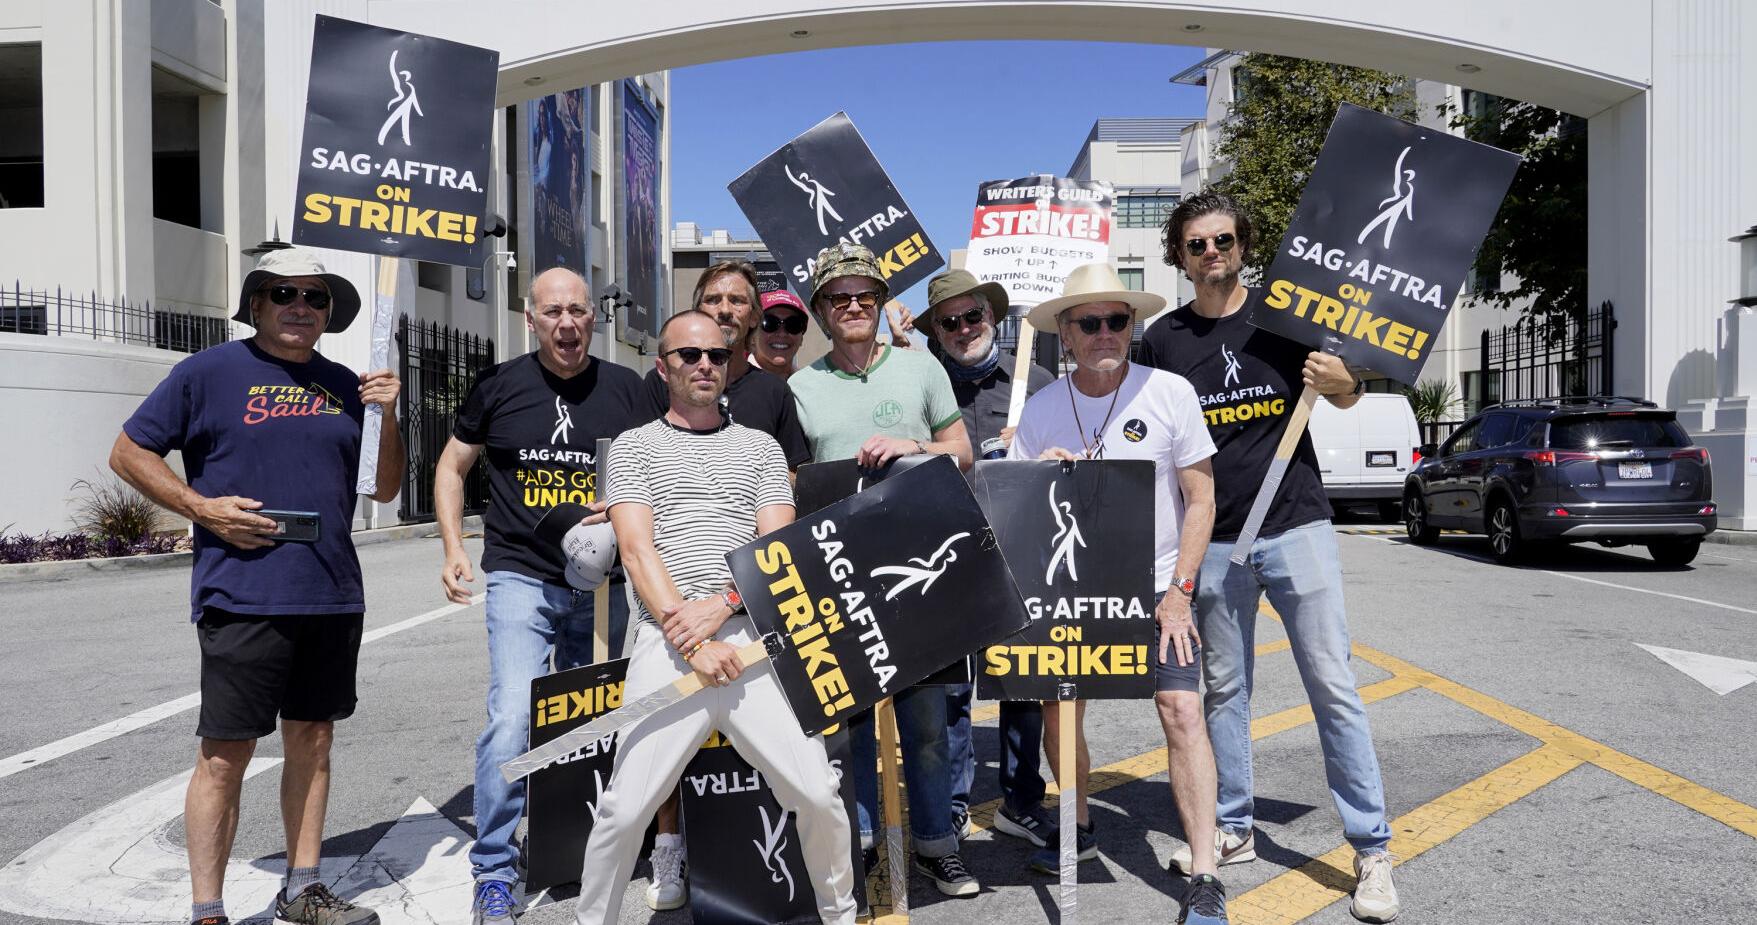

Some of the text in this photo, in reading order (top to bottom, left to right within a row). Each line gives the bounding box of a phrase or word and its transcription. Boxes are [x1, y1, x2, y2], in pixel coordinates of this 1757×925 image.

[376, 184, 411, 203] ON
[1057, 188, 1104, 202] GUILD
[303, 193, 478, 244] STRIKE!
[980, 209, 1101, 240] STRIKE!
[983, 245, 1094, 259] SHOW BUDGETS
[1027, 258, 1045, 266] UP
[980, 271, 1030, 281] WRITING
[1012, 282, 1054, 293] DOWN
[1338, 283, 1373, 307] ON
[1264, 279, 1430, 361] STRIKE!
[248, 385, 305, 395] BETTER
[274, 394, 309, 404] CALL
[243, 394, 325, 425] Saul
[516, 468, 565, 487] #ADS
[818, 597, 845, 634] ON
[755, 540, 856, 717] STRIKE!
[1050, 626, 1083, 642] ON
[985, 644, 1148, 676] STRIKE!
[536, 681, 625, 728] RIKE!
